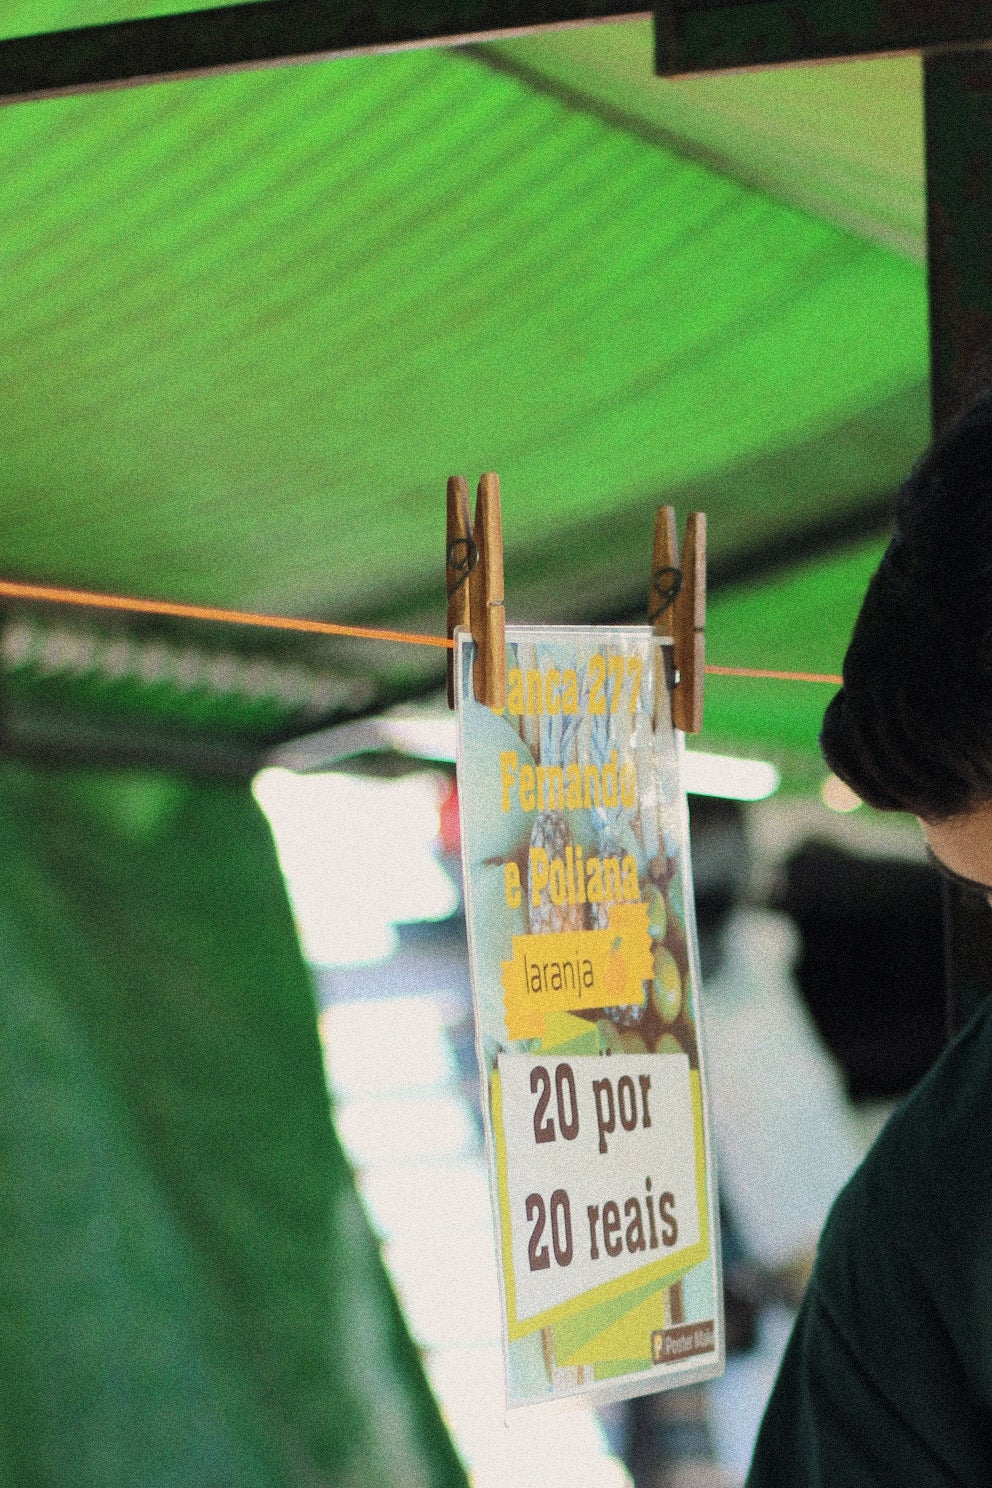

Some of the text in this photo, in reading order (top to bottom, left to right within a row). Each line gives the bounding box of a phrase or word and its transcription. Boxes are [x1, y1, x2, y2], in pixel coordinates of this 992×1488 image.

[490, 653, 643, 716] anca 277
[500, 751, 636, 813] Fernando
[504, 844, 641, 909] e Poliana
[523, 954, 596, 999] laranja
[529, 1063, 652, 1154] 20 por
[525, 1176, 679, 1272] 20 reais
